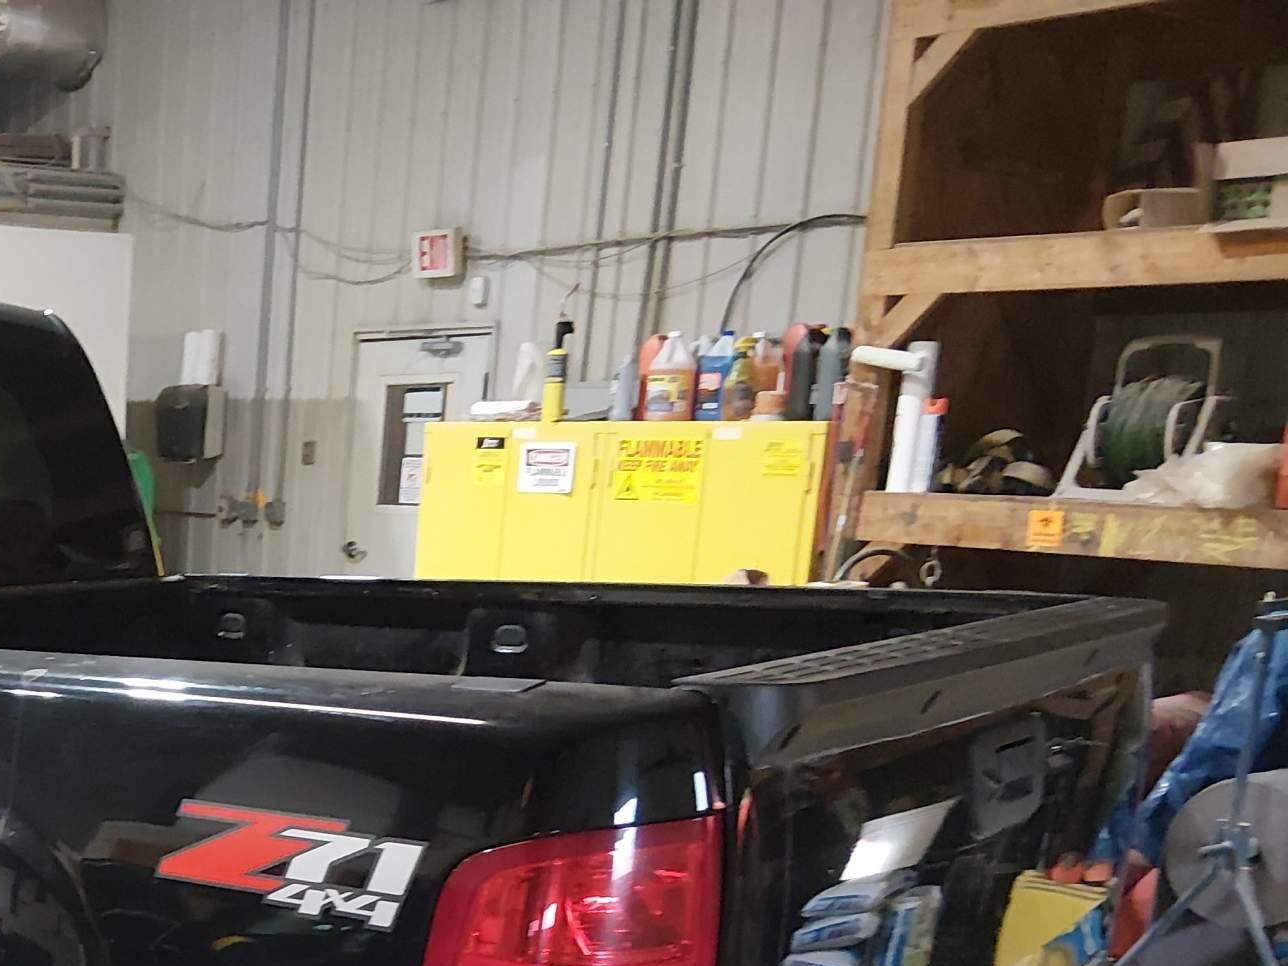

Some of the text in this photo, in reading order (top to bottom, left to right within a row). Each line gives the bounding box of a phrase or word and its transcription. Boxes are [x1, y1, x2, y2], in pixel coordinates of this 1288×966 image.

[617, 440, 703, 458] FLAMMABLE
[617, 459, 642, 472] KEEP
[644, 459, 668, 473] FIRE
[156, 799, 428, 894] Z71
